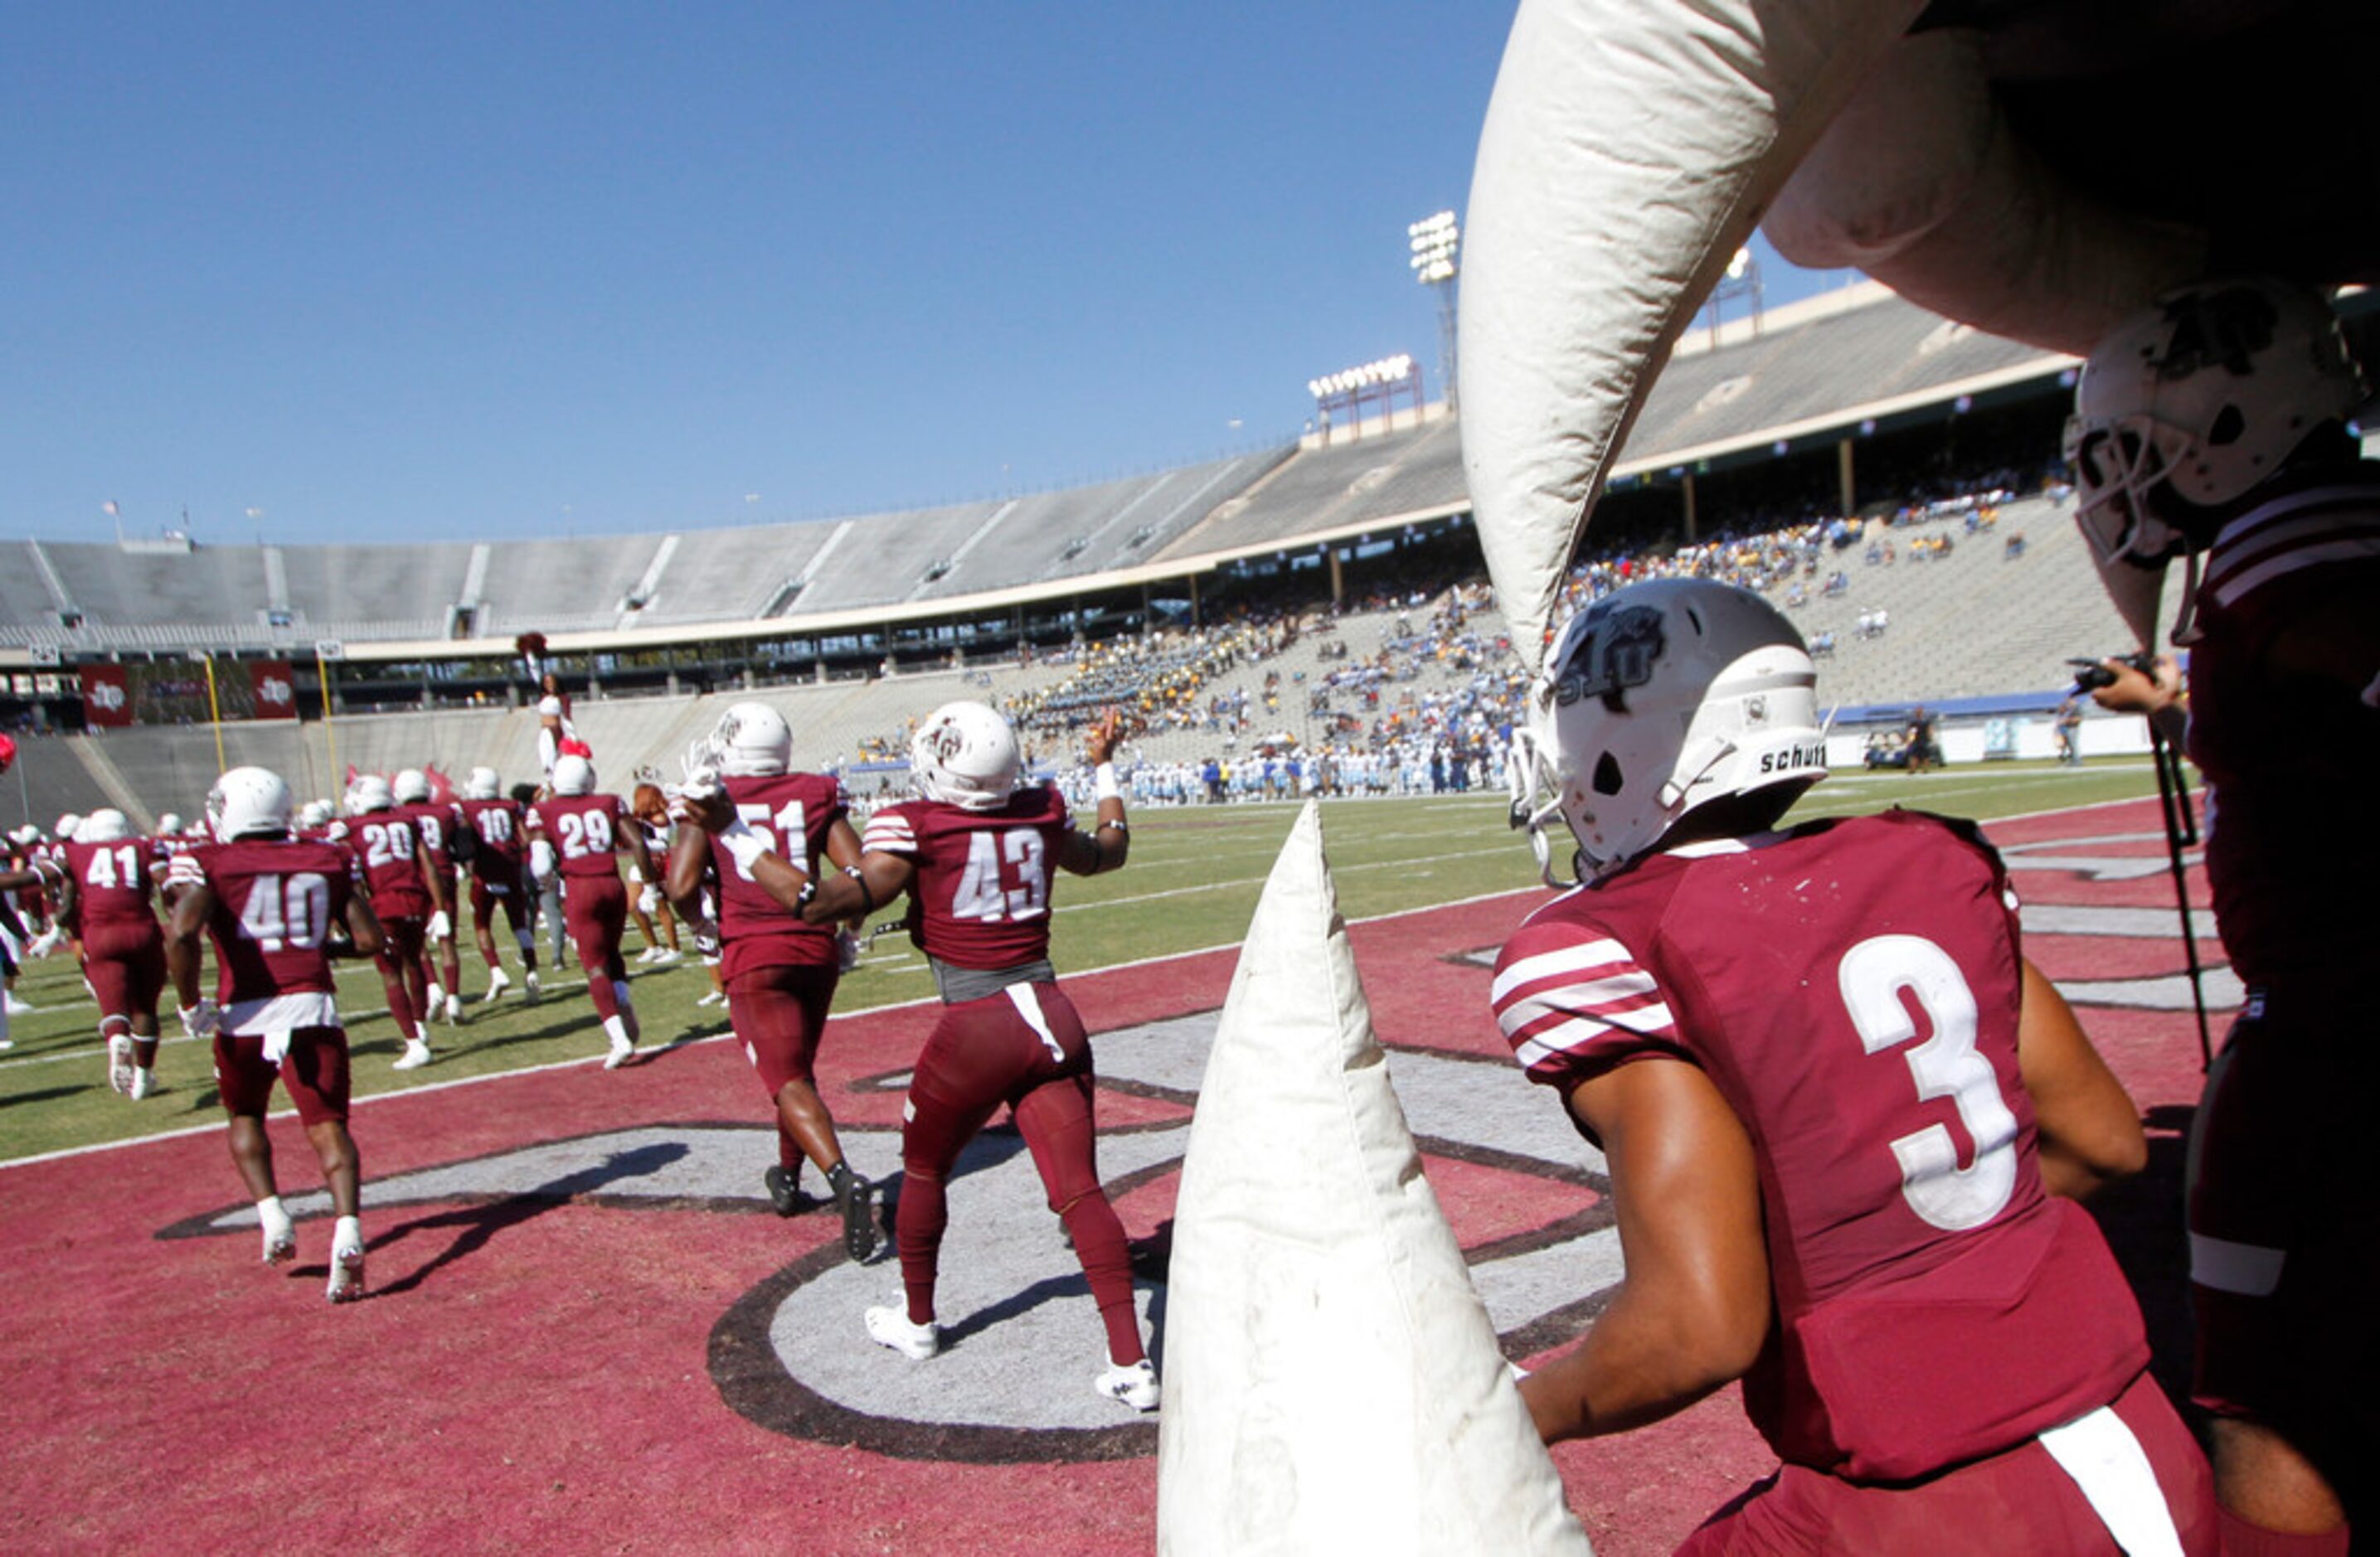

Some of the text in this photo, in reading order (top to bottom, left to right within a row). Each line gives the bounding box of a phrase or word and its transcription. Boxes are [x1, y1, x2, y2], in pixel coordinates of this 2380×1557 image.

[362, 822, 413, 867] 20
[477, 808, 512, 845] 10
[557, 808, 612, 859] 29
[735, 799, 809, 882] 51
[87, 845, 138, 888] 41
[952, 827, 1046, 922] 43
[238, 873, 328, 951] 40
[1838, 934, 2018, 1230] 3
